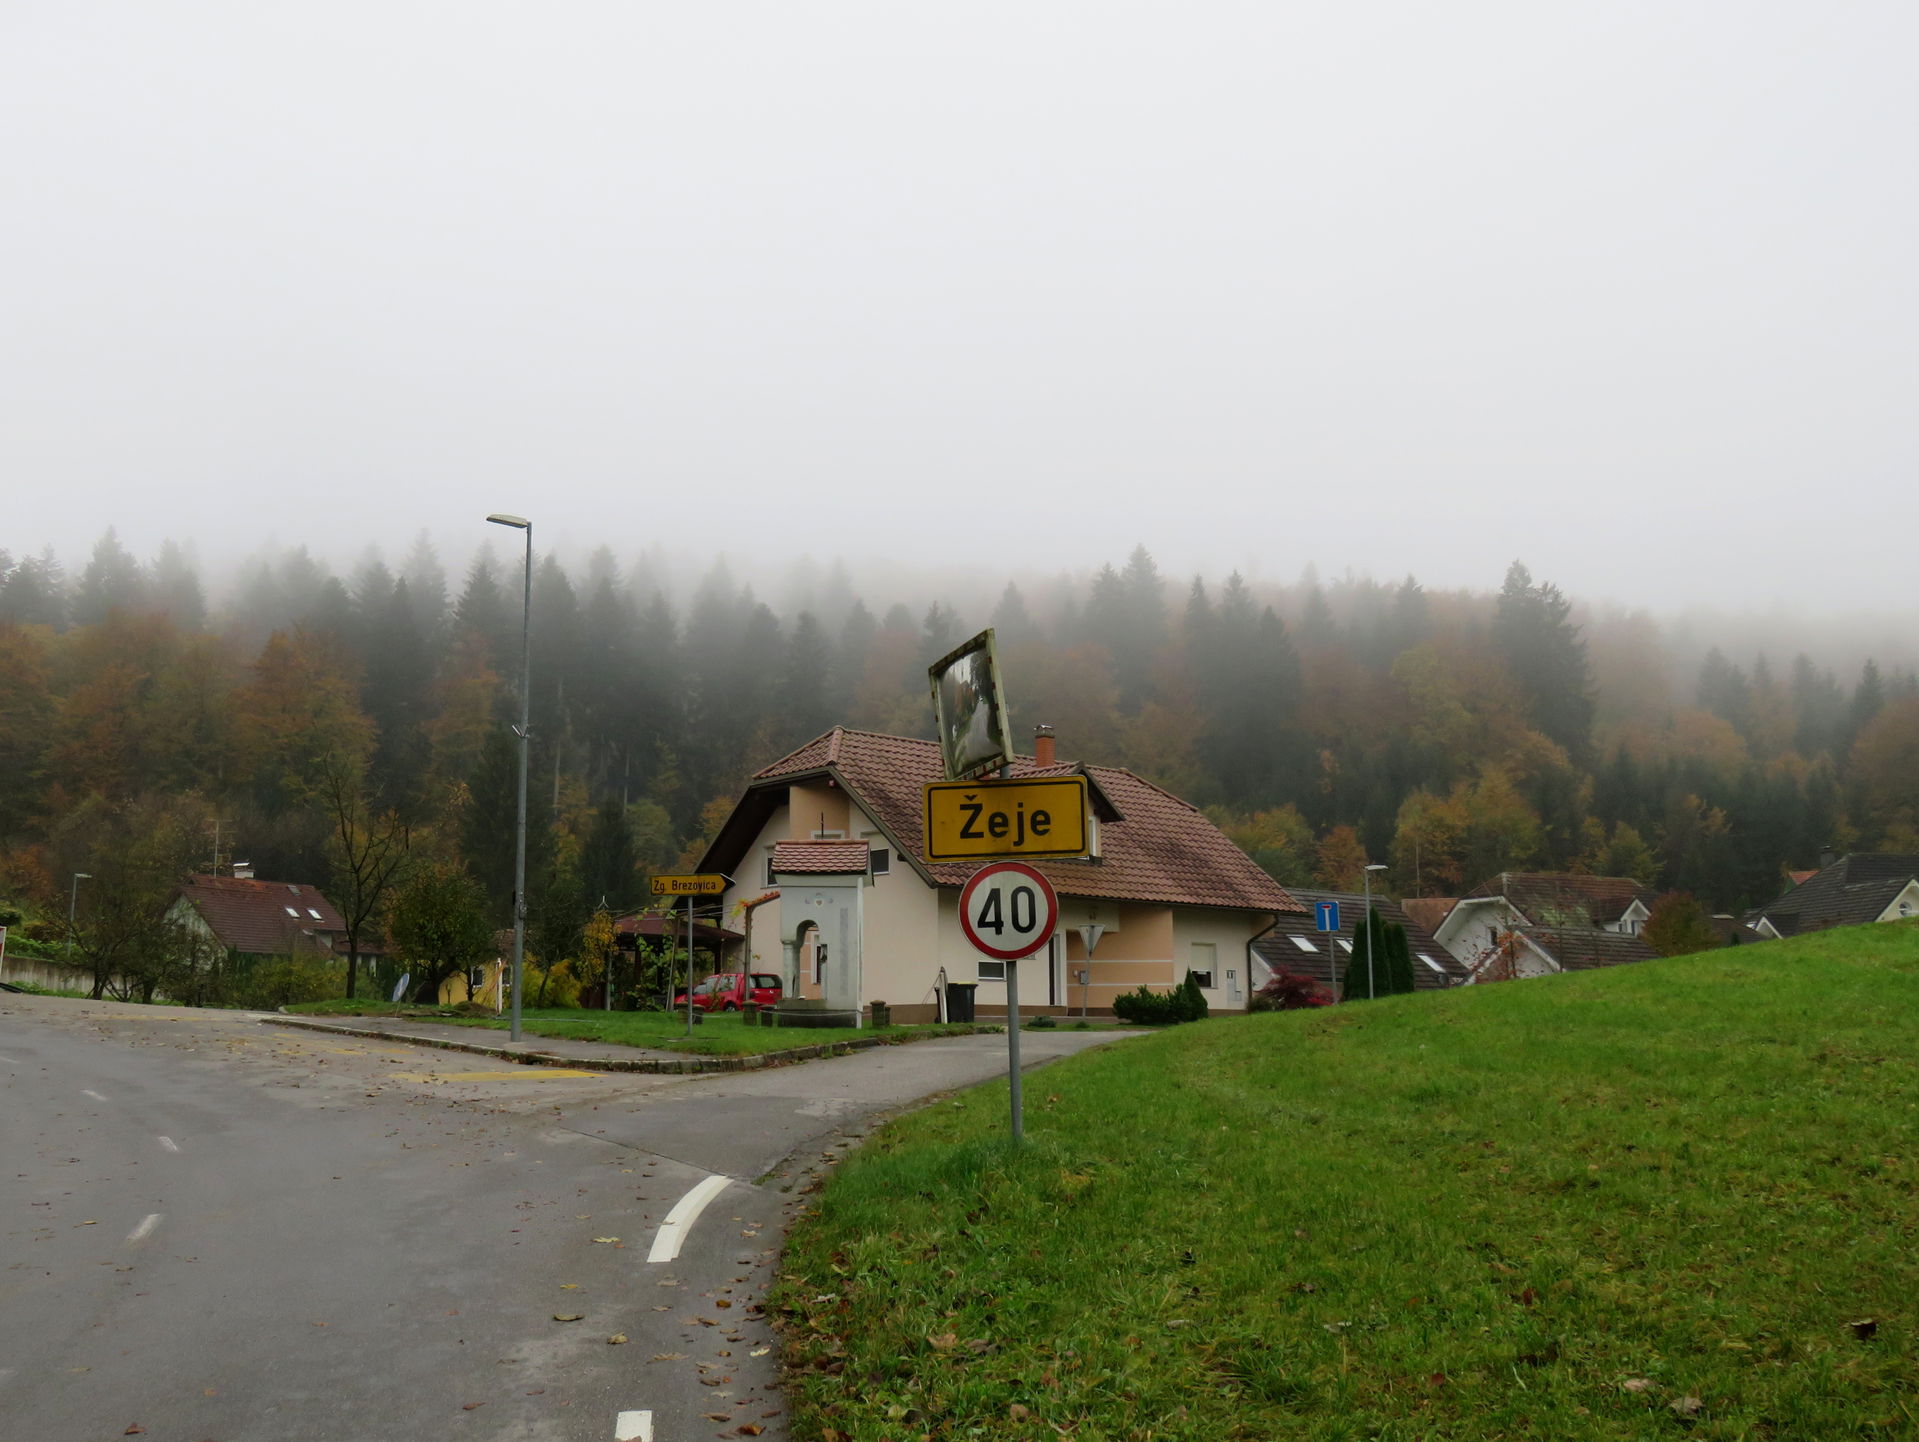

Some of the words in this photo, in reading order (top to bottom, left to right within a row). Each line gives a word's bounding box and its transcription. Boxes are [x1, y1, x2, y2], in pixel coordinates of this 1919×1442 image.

[960, 794, 1051, 847] Žeje
[672, 880, 717, 892] Brezovica
[977, 885, 1037, 936] 40
